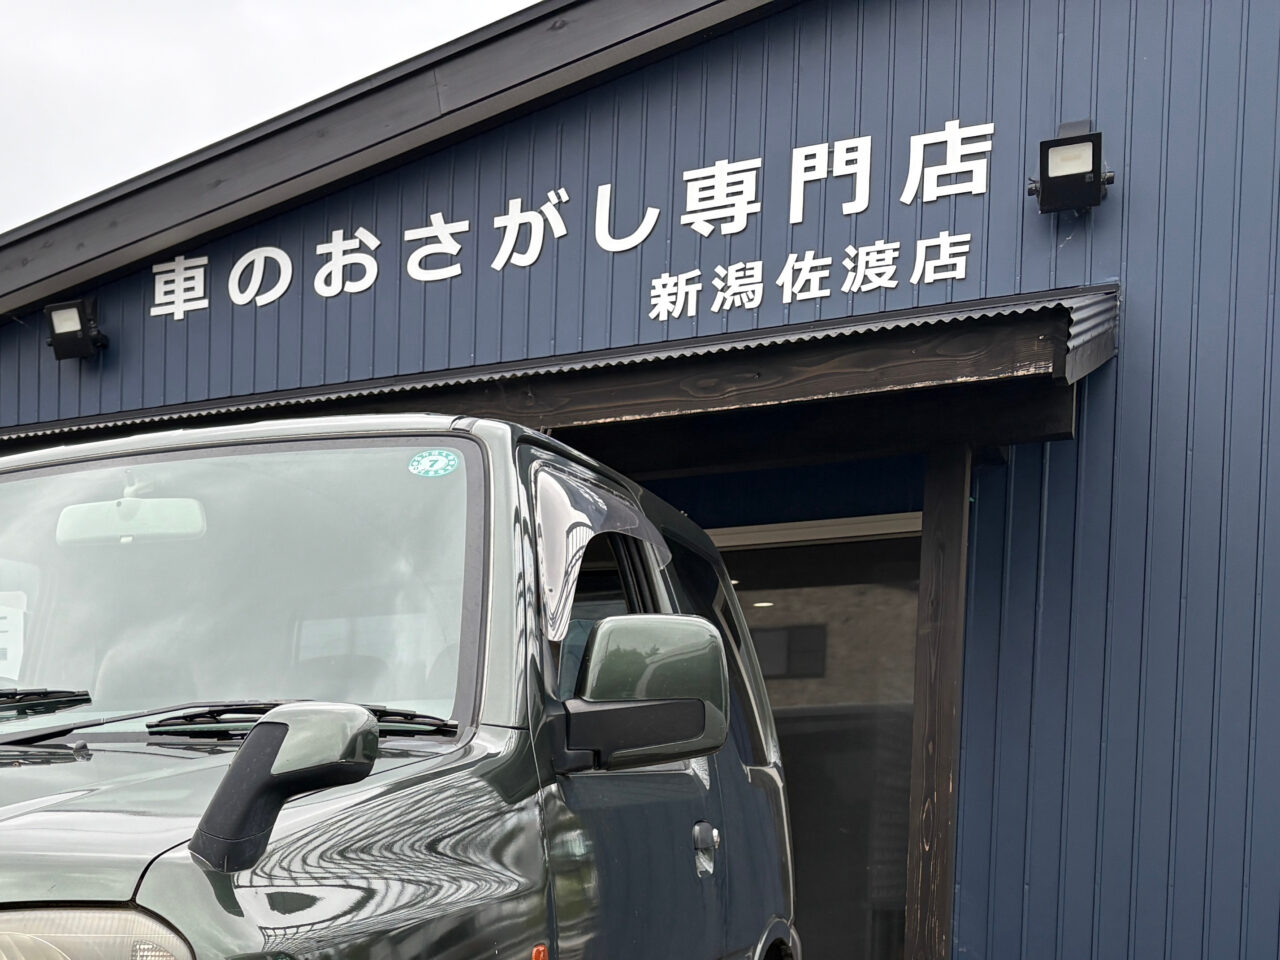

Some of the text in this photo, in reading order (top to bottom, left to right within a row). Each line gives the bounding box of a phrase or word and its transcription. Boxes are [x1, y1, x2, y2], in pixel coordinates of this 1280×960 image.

[149, 119, 996, 321] 車のおさがし専門店
[649, 231, 973, 321] 新潟佐渡店
